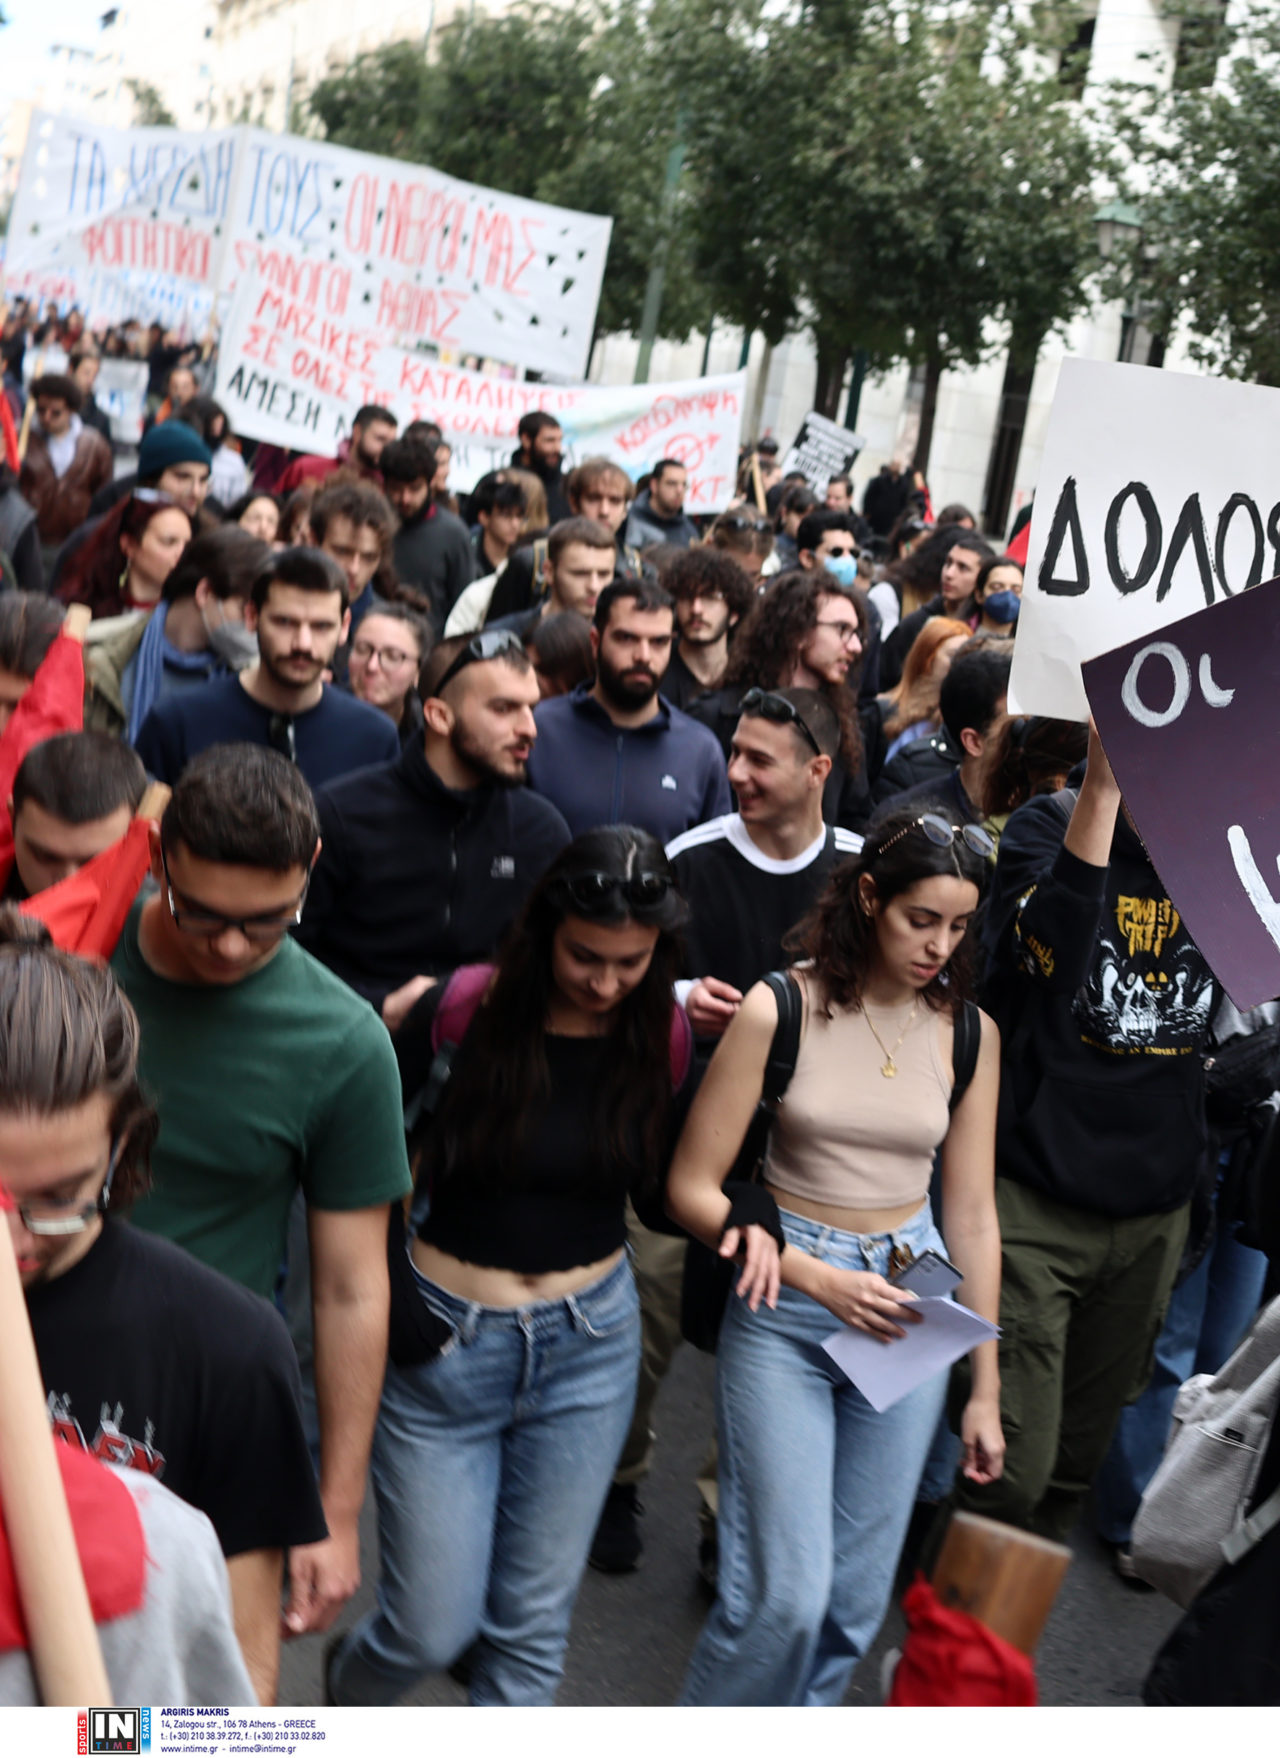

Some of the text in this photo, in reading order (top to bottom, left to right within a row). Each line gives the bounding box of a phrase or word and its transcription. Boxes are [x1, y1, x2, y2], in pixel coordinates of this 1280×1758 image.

[247, 143, 338, 244] ΤΟΥΣ
[466, 206, 545, 296] ΜΑΣ
[228, 364, 322, 432] ΑΜΕΣΗ
